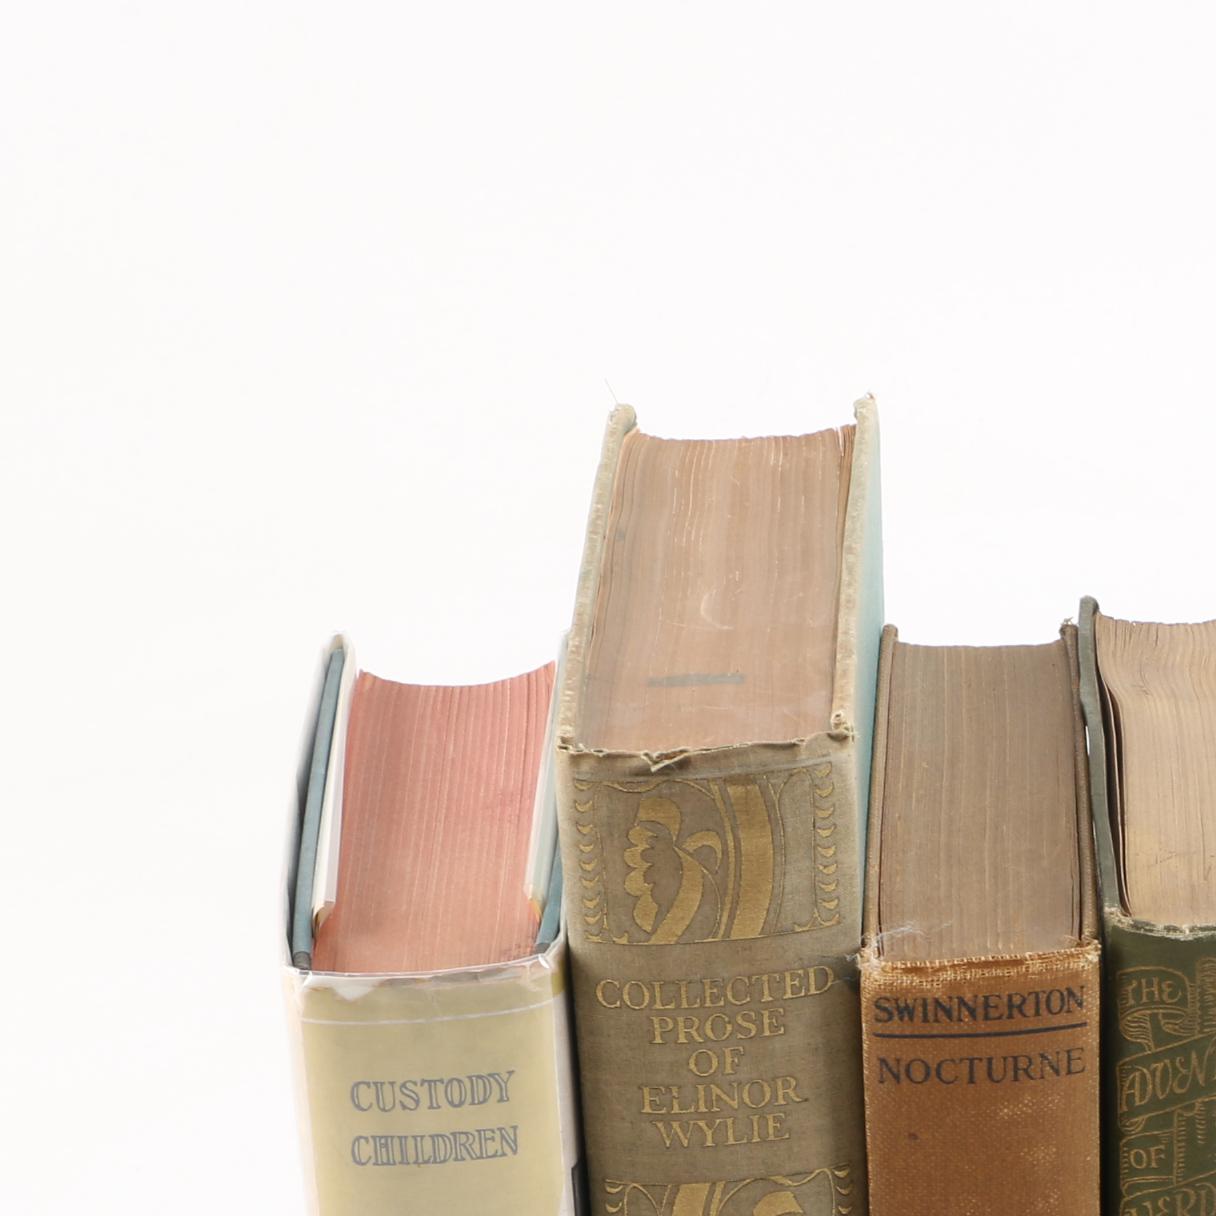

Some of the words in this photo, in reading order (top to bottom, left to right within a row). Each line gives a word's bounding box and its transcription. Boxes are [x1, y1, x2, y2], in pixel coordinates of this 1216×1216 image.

[596, 965, 834, 1010] COLLECTED
[874, 985, 1085, 1023] SWINNERTON
[1125, 977, 1181, 1005] THE
[650, 1008, 784, 1043] PROSE
[688, 1047, 744, 1076] OF
[878, 1048, 1086, 1085] NOCTURNE
[351, 1070, 515, 1112] CUSTODY
[640, 1076, 808, 1114] ELINOR
[352, 1126, 518, 1166] CHILDREN
[652, 1113, 790, 1148] WYLIE
[1130, 1145, 1165, 1169] OF
